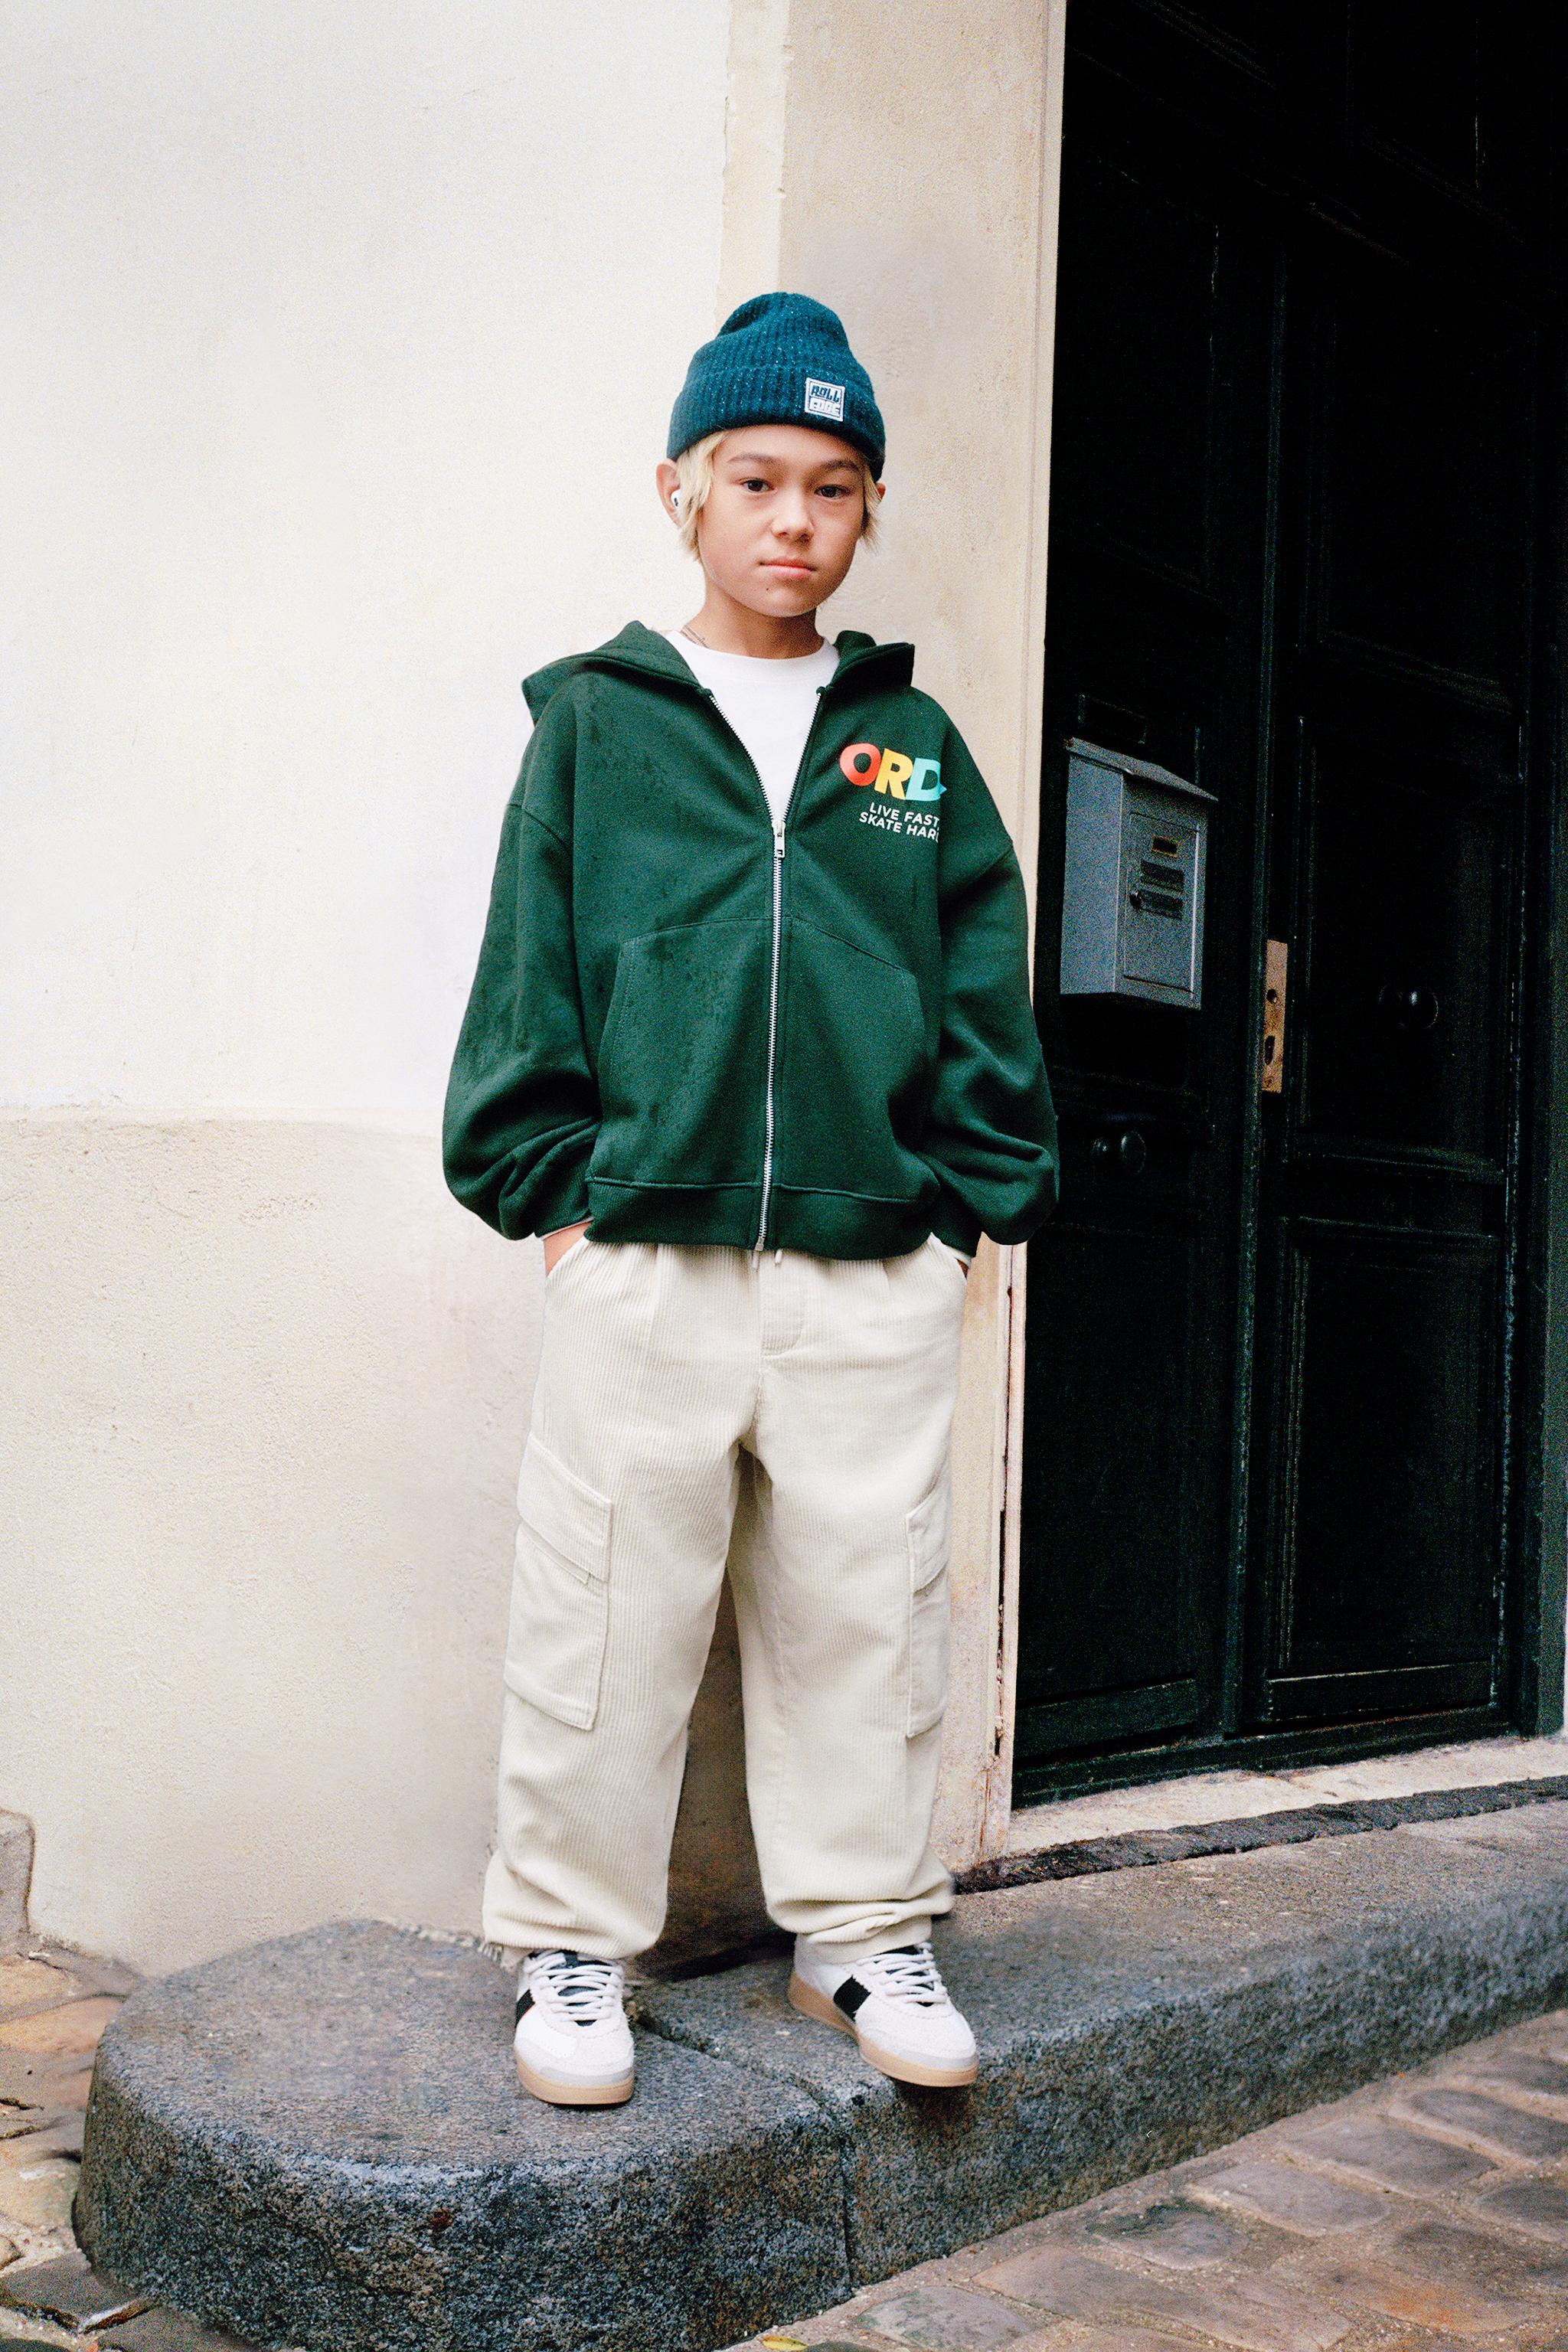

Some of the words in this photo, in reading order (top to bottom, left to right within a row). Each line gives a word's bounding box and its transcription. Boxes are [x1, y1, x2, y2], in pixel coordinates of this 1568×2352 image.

[811, 385, 840, 402] ROLL
[869, 802, 900, 821] LIVE
[859, 812, 902, 833] SKATE
